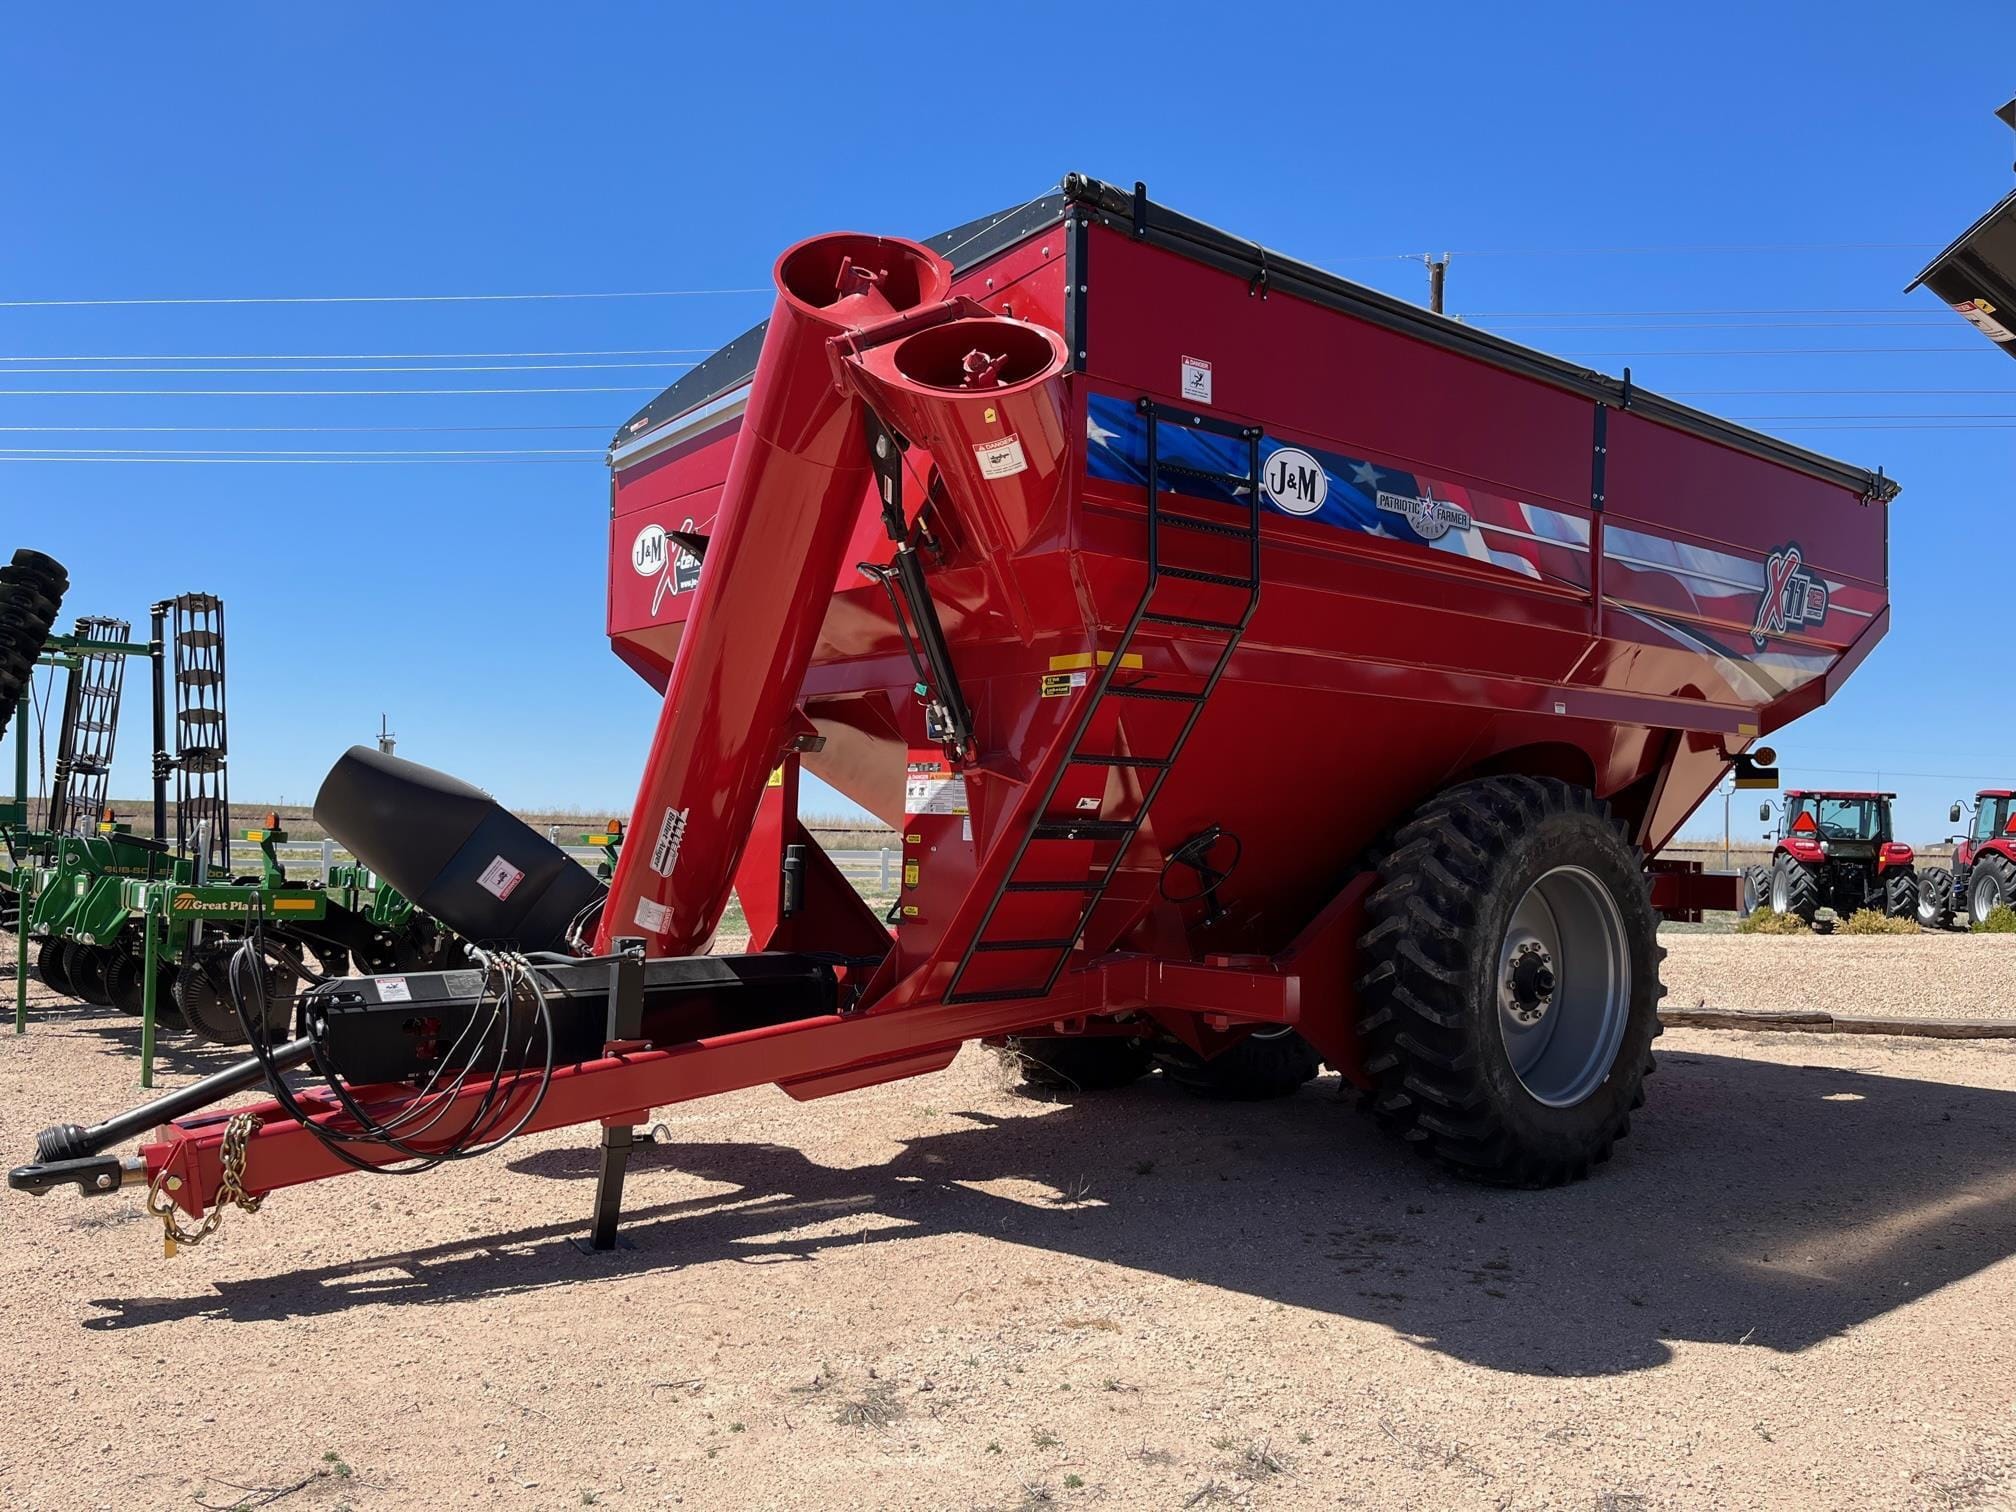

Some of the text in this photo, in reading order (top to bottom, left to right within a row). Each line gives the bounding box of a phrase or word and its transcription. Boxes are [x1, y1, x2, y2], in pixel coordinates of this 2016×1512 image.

[1270, 460, 1318, 504] J&M
[1379, 494, 1468, 527] PATRIOTIC FARMER
[636, 535, 662, 567] J&M
[653, 811, 676, 869] Bullet Auger
[192, 900, 267, 911] Great Plans
